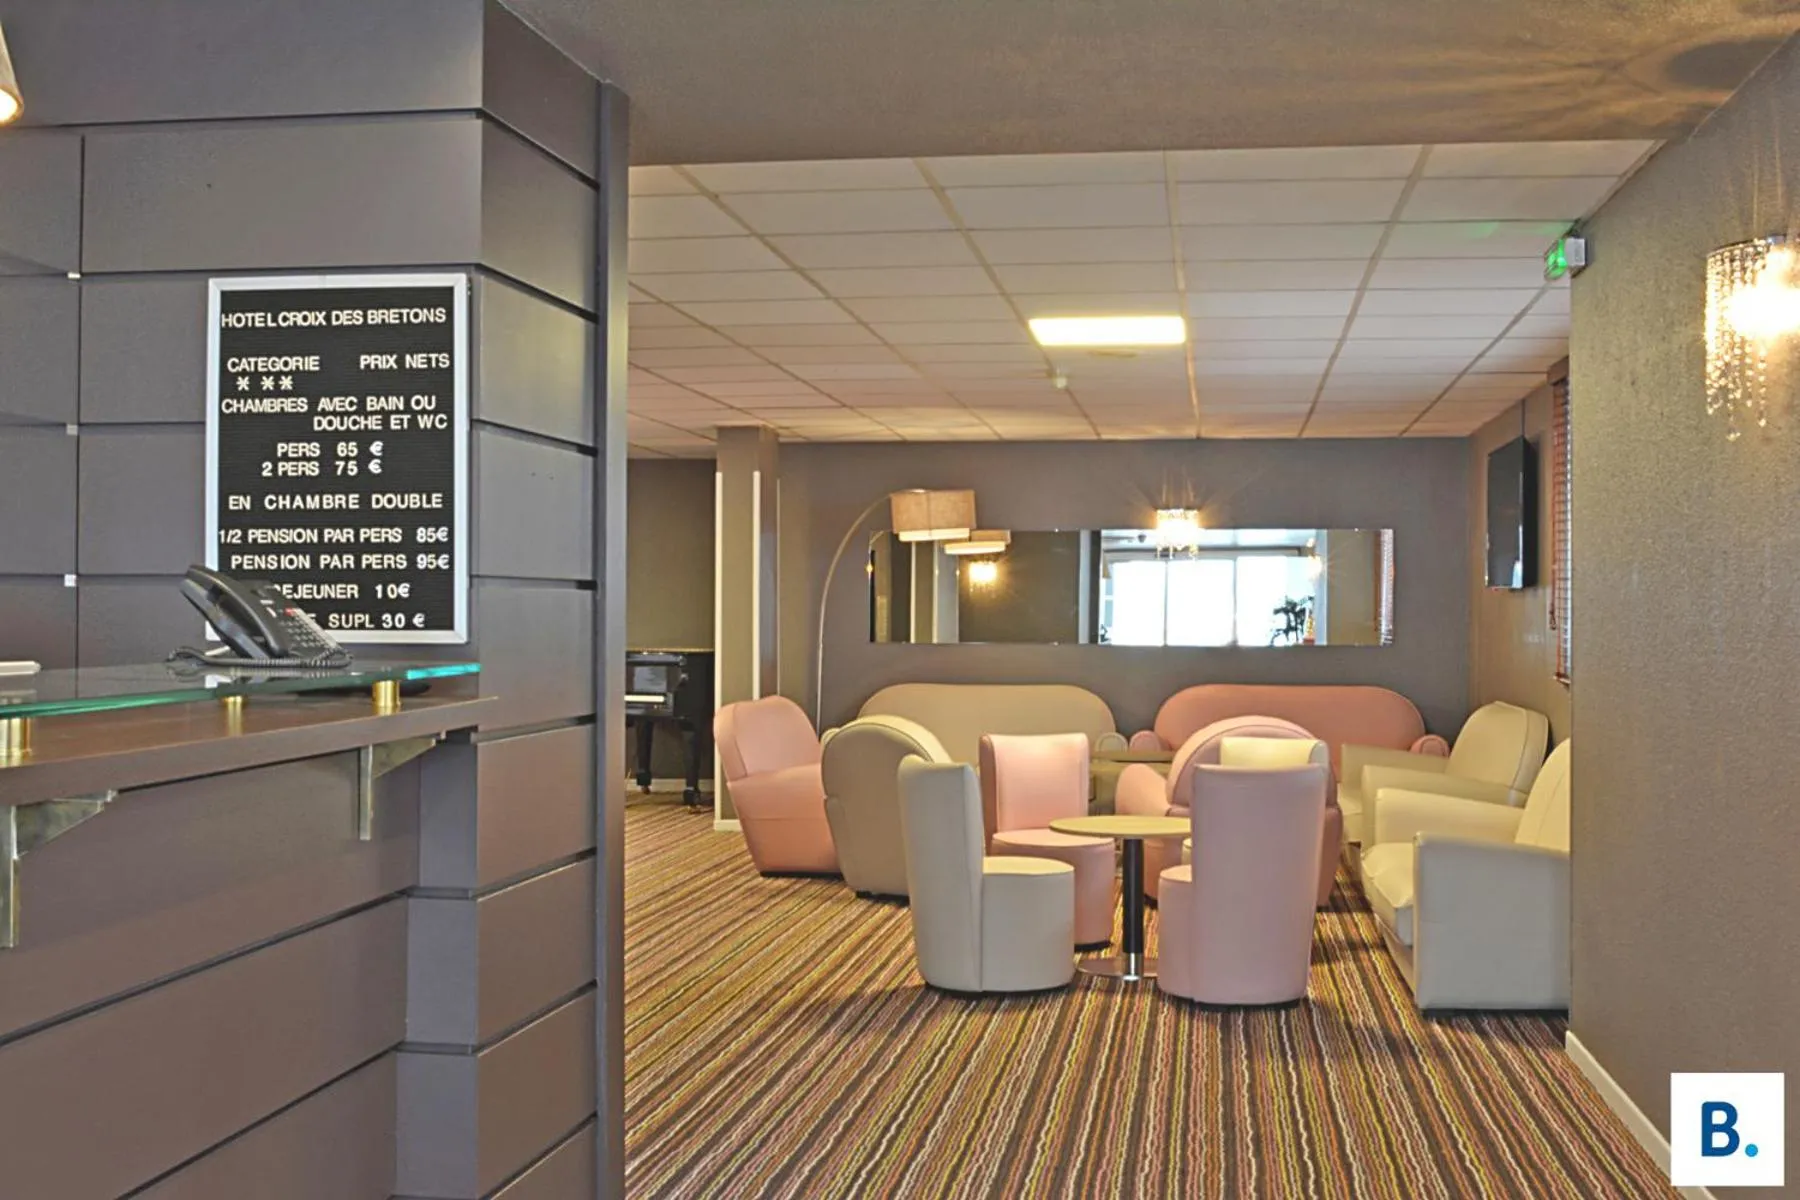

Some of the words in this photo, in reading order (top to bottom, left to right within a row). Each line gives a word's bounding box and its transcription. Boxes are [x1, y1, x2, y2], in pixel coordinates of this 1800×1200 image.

[278, 311, 326, 326] CROIX
[332, 310, 363, 325] DES
[368, 308, 446, 325] BRETONS
[227, 356, 320, 372] CATEGORIE
[360, 354, 397, 370] PRIX
[405, 354, 450, 368] NETS
[221, 398, 308, 414] CHAMBRES
[317, 397, 357, 411] AVEC
[367, 396, 403, 411] BAIN
[411, 395, 436, 410] OU
[314, 416, 382, 431] DOUCHE
[390, 415, 411, 429] ET
[418, 414, 448, 429] WC
[277, 443, 320, 458] PERS
[337, 442, 358, 457] 65
[370, 441, 383, 456] €
[262, 462, 272, 477] 2
[278, 462, 320, 476] PERS
[335, 461, 358, 476] 75
[368, 459, 382, 474] €
[229, 496, 250, 510] EN
[264, 494, 359, 510] CHAMBRE
[372, 493, 442, 509] DOUBLE
[218, 529, 242, 544] 1/2
[248, 529, 318, 543] PENSION
[324, 528, 354, 543] PAR
[360, 528, 402, 543] PERS
[231, 555, 310, 570] PENSION
[320, 555, 354, 569] PAR
[361, 554, 407, 569] PERS
[328, 614, 374, 629] SUPL
[382, 613, 405, 628] 30
[413, 613, 425, 628] €
